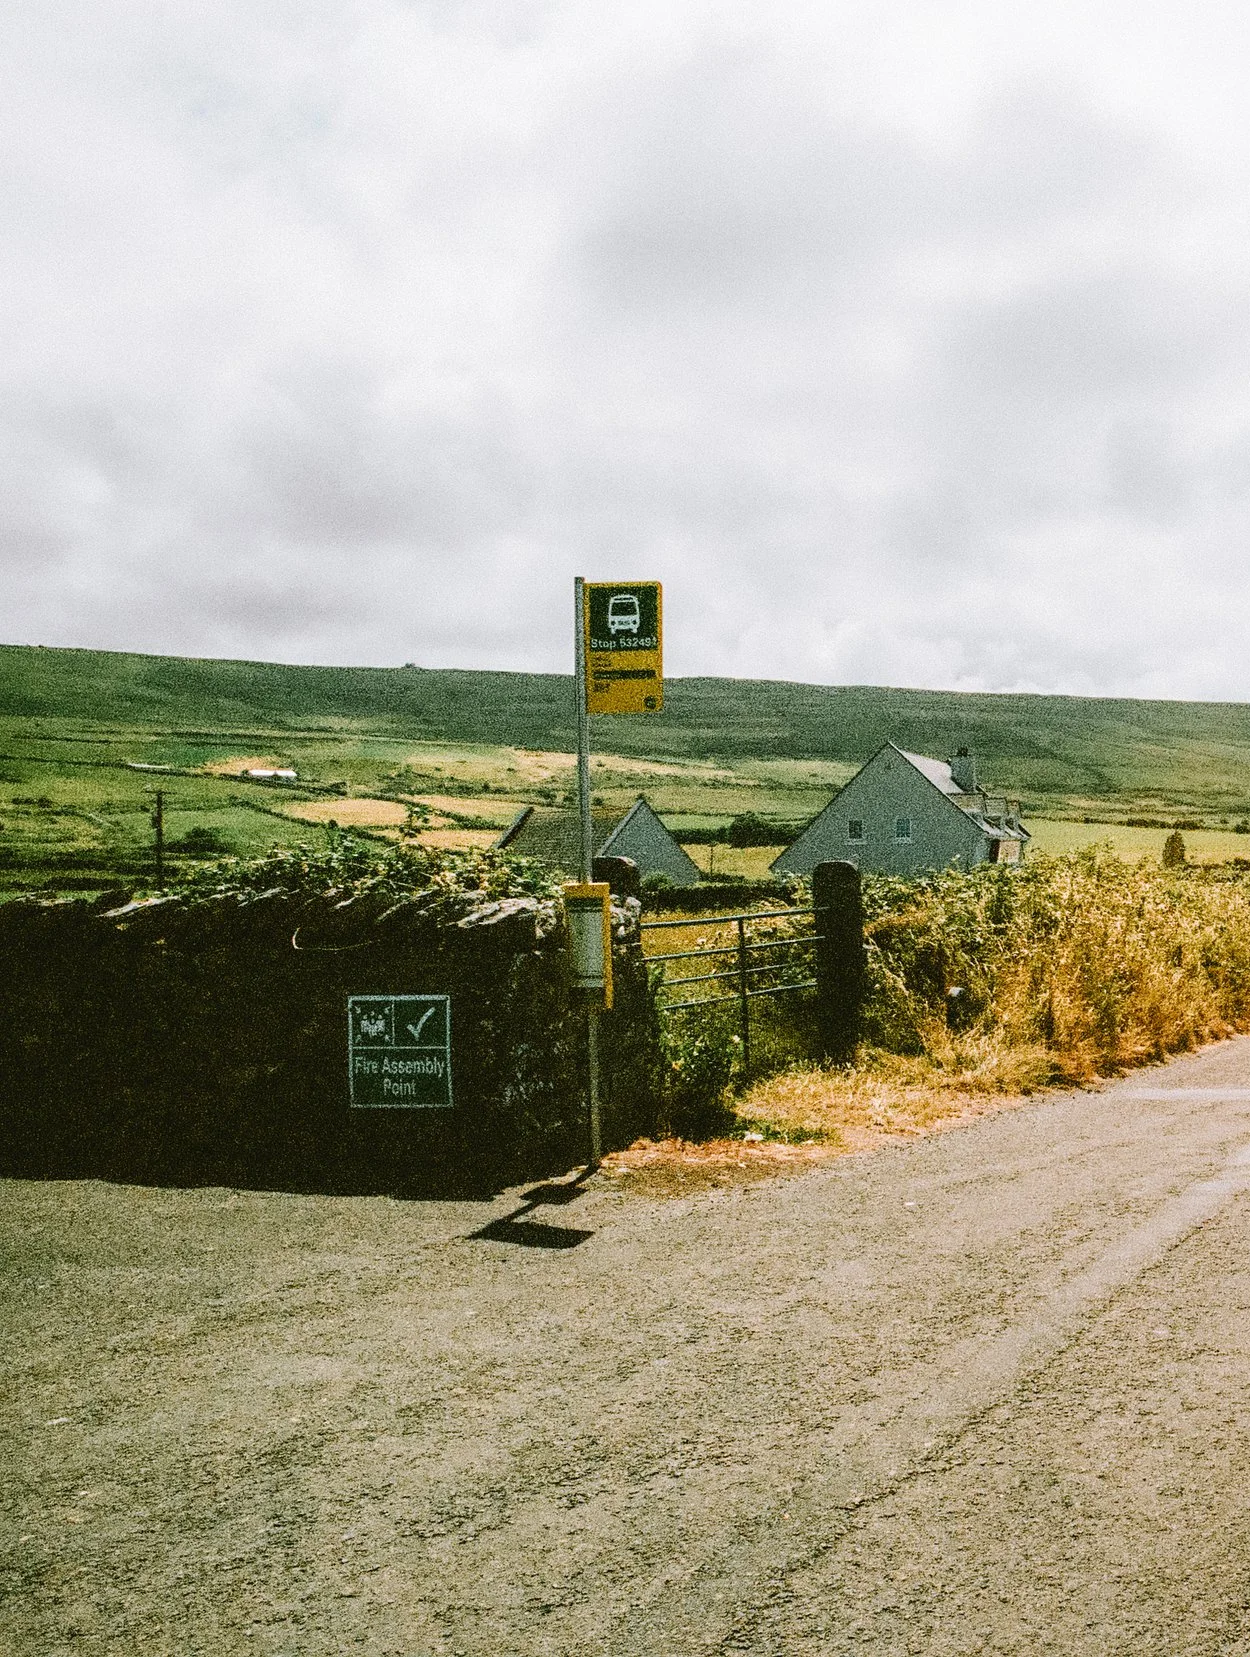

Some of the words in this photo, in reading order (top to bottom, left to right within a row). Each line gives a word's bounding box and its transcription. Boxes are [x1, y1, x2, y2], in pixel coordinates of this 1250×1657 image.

[591, 638, 616, 651] Stop
[355, 1056, 379, 1075] Fire
[381, 1056, 445, 1078] Assembly
[383, 1078, 416, 1097] Point
